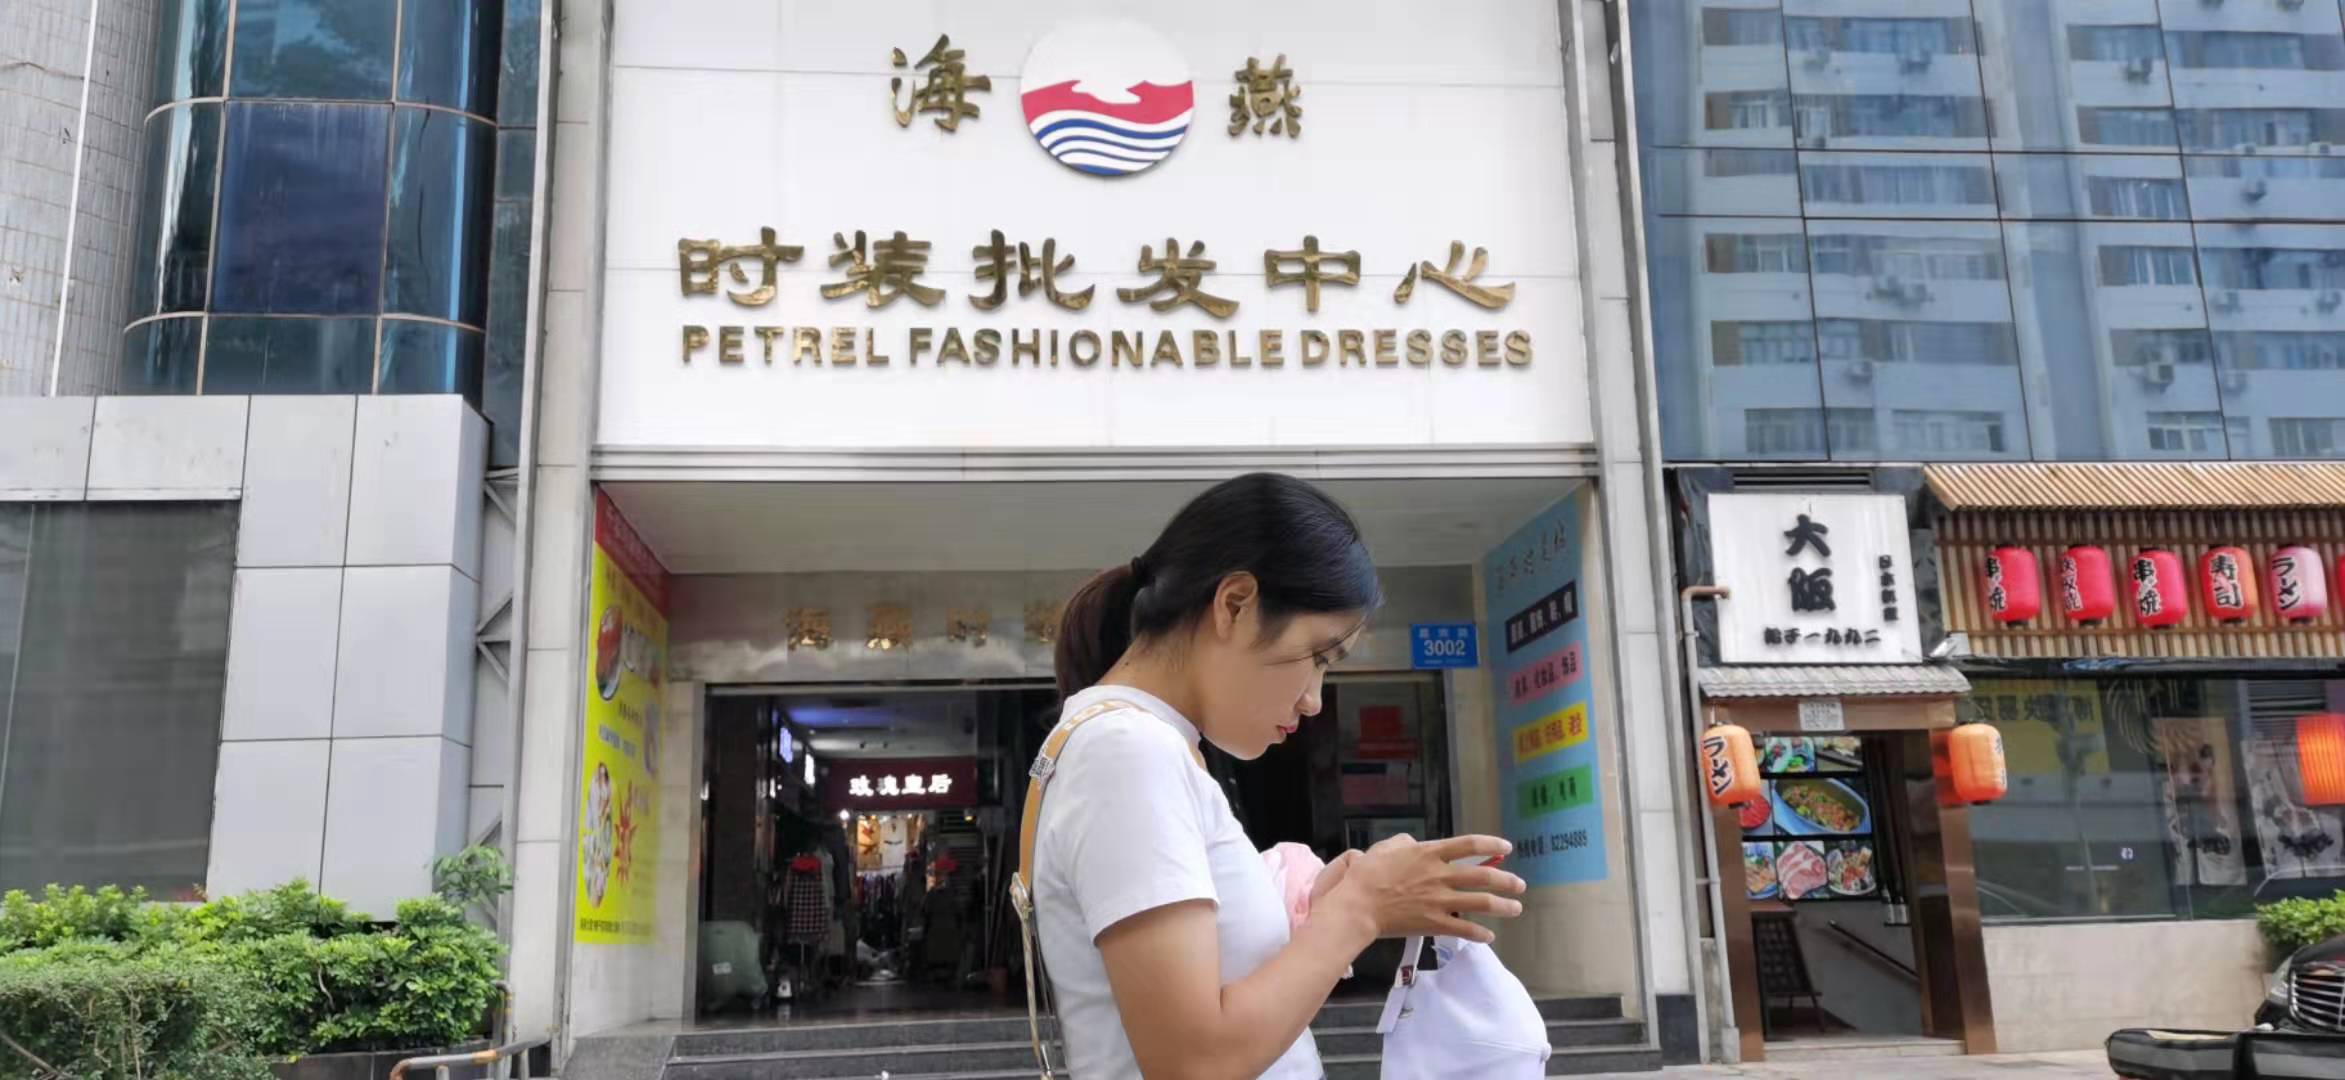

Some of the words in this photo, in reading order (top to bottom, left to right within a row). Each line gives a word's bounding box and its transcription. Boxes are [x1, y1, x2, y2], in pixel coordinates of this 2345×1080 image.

[678, 226, 1516, 320] 时装批发中心
[681, 325, 890, 366] PETREL
[908, 327, 1285, 368] FASHIONABLE
[1300, 329, 1534, 369] DRESSES
[1784, 514, 1837, 612] 大阪
[2210, 554, 2243, 609] 寿司
[2271, 556, 2301, 611] ラーメン
[1423, 640, 1467, 657] 3002
[848, 773, 953, 797] 玫瑰皇后
[1703, 736, 1732, 796] ラーメン
